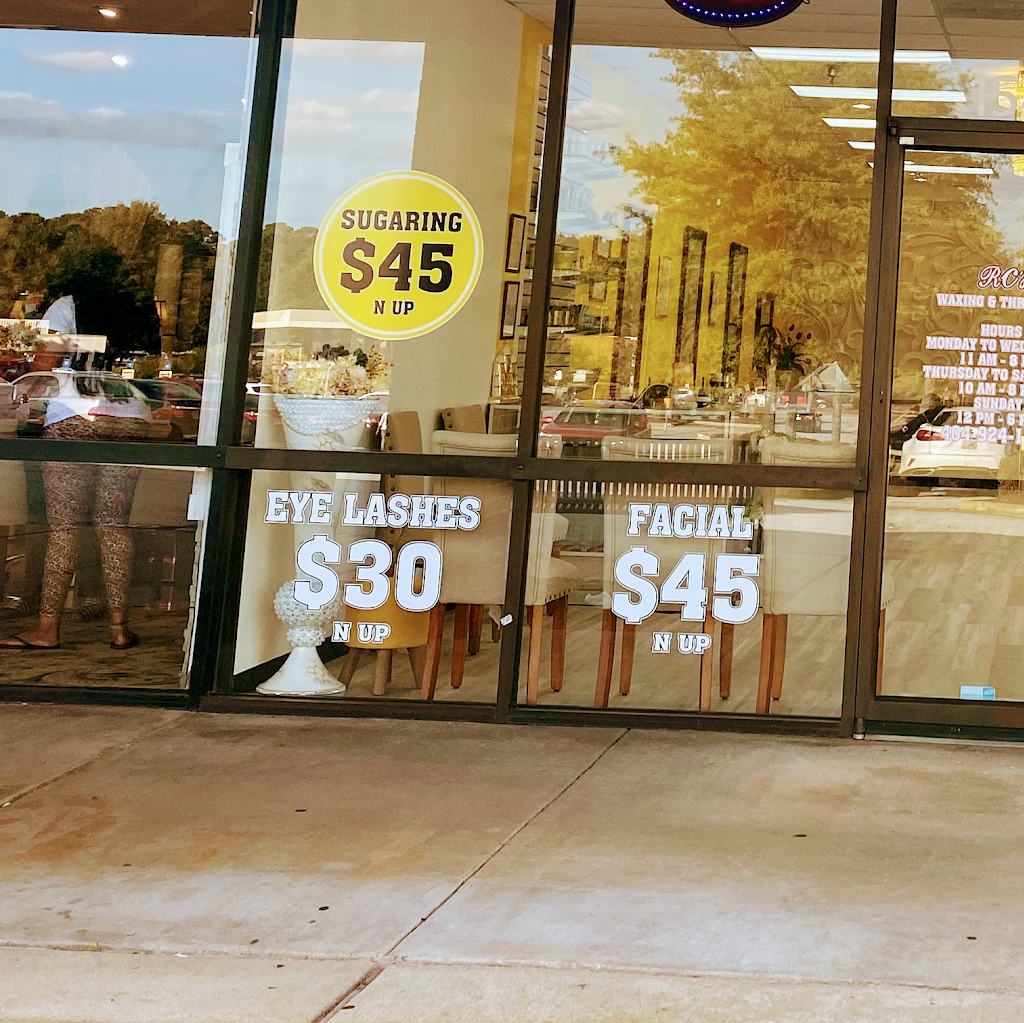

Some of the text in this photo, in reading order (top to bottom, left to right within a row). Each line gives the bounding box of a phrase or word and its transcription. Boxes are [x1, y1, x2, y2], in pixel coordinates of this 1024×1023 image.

[341, 209, 463, 233] SUGARING
[340, 237, 455, 294] $45
[373, 300, 414, 315] N UP
[936, 293, 984, 308] WAXING
[987, 296, 996, 309] &
[980, 323, 1023, 338] HOURS
[925, 335, 978, 352] MONDAY
[981, 338, 997, 352] TO
[959, 351, 974, 366] 11
[977, 353, 998, 367] AM
[1008, 354, 1018, 367] 8
[922, 364, 989, 381] THURSDAY
[991, 368, 1009, 381] TO
[958, 380, 974, 395] 10
[977, 382, 997, 396] AM
[1007, 384, 1017, 397] 8
[973, 396, 1024, 412] SUNDAY
[957, 410, 973, 425] 12
[975, 411, 995, 425] PM
[264, 490, 482, 532] EYE LASHES
[627, 503, 754, 541] FACIAL
[292, 534, 443, 612] $30
[611, 546, 760, 625] $45
[332, 623, 391, 644] N UP
[652, 632, 712, 655] N UP
